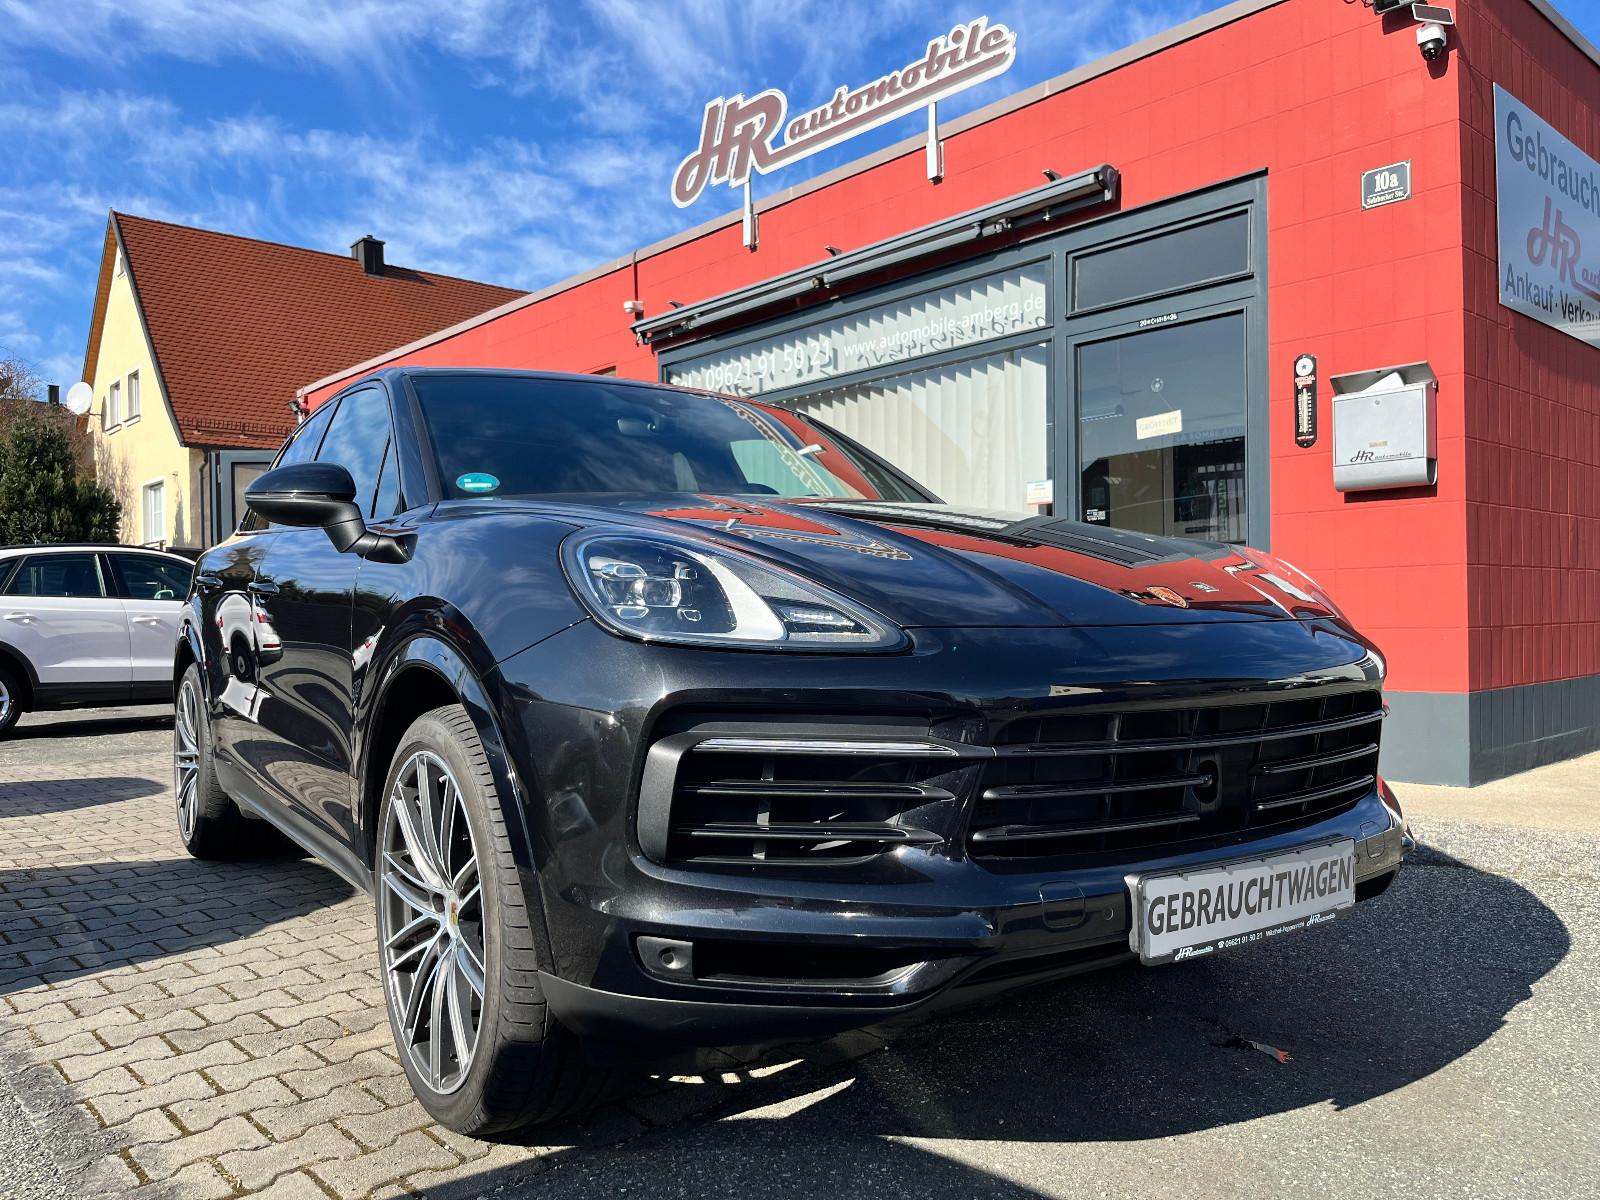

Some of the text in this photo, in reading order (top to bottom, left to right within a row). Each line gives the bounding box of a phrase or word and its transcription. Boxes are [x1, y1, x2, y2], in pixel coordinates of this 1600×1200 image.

[673, 23, 1010, 204] HR automobile
[1374, 171, 1399, 192] 10a
[1505, 263, 1600, 323] Ankauf Verkau
[705, 361, 751, 390] 09621
[758, 351, 776, 378] 91
[784, 346, 804, 373] 50
[810, 339, 830, 366] 21
[843, 294, 1043, 357] www.automobile-amberg.de
[1148, 855, 1352, 936] GEBRAUCHTWAGEN
[1241, 935, 1248, 943] 91
[1256, 931, 1263, 940] 21
